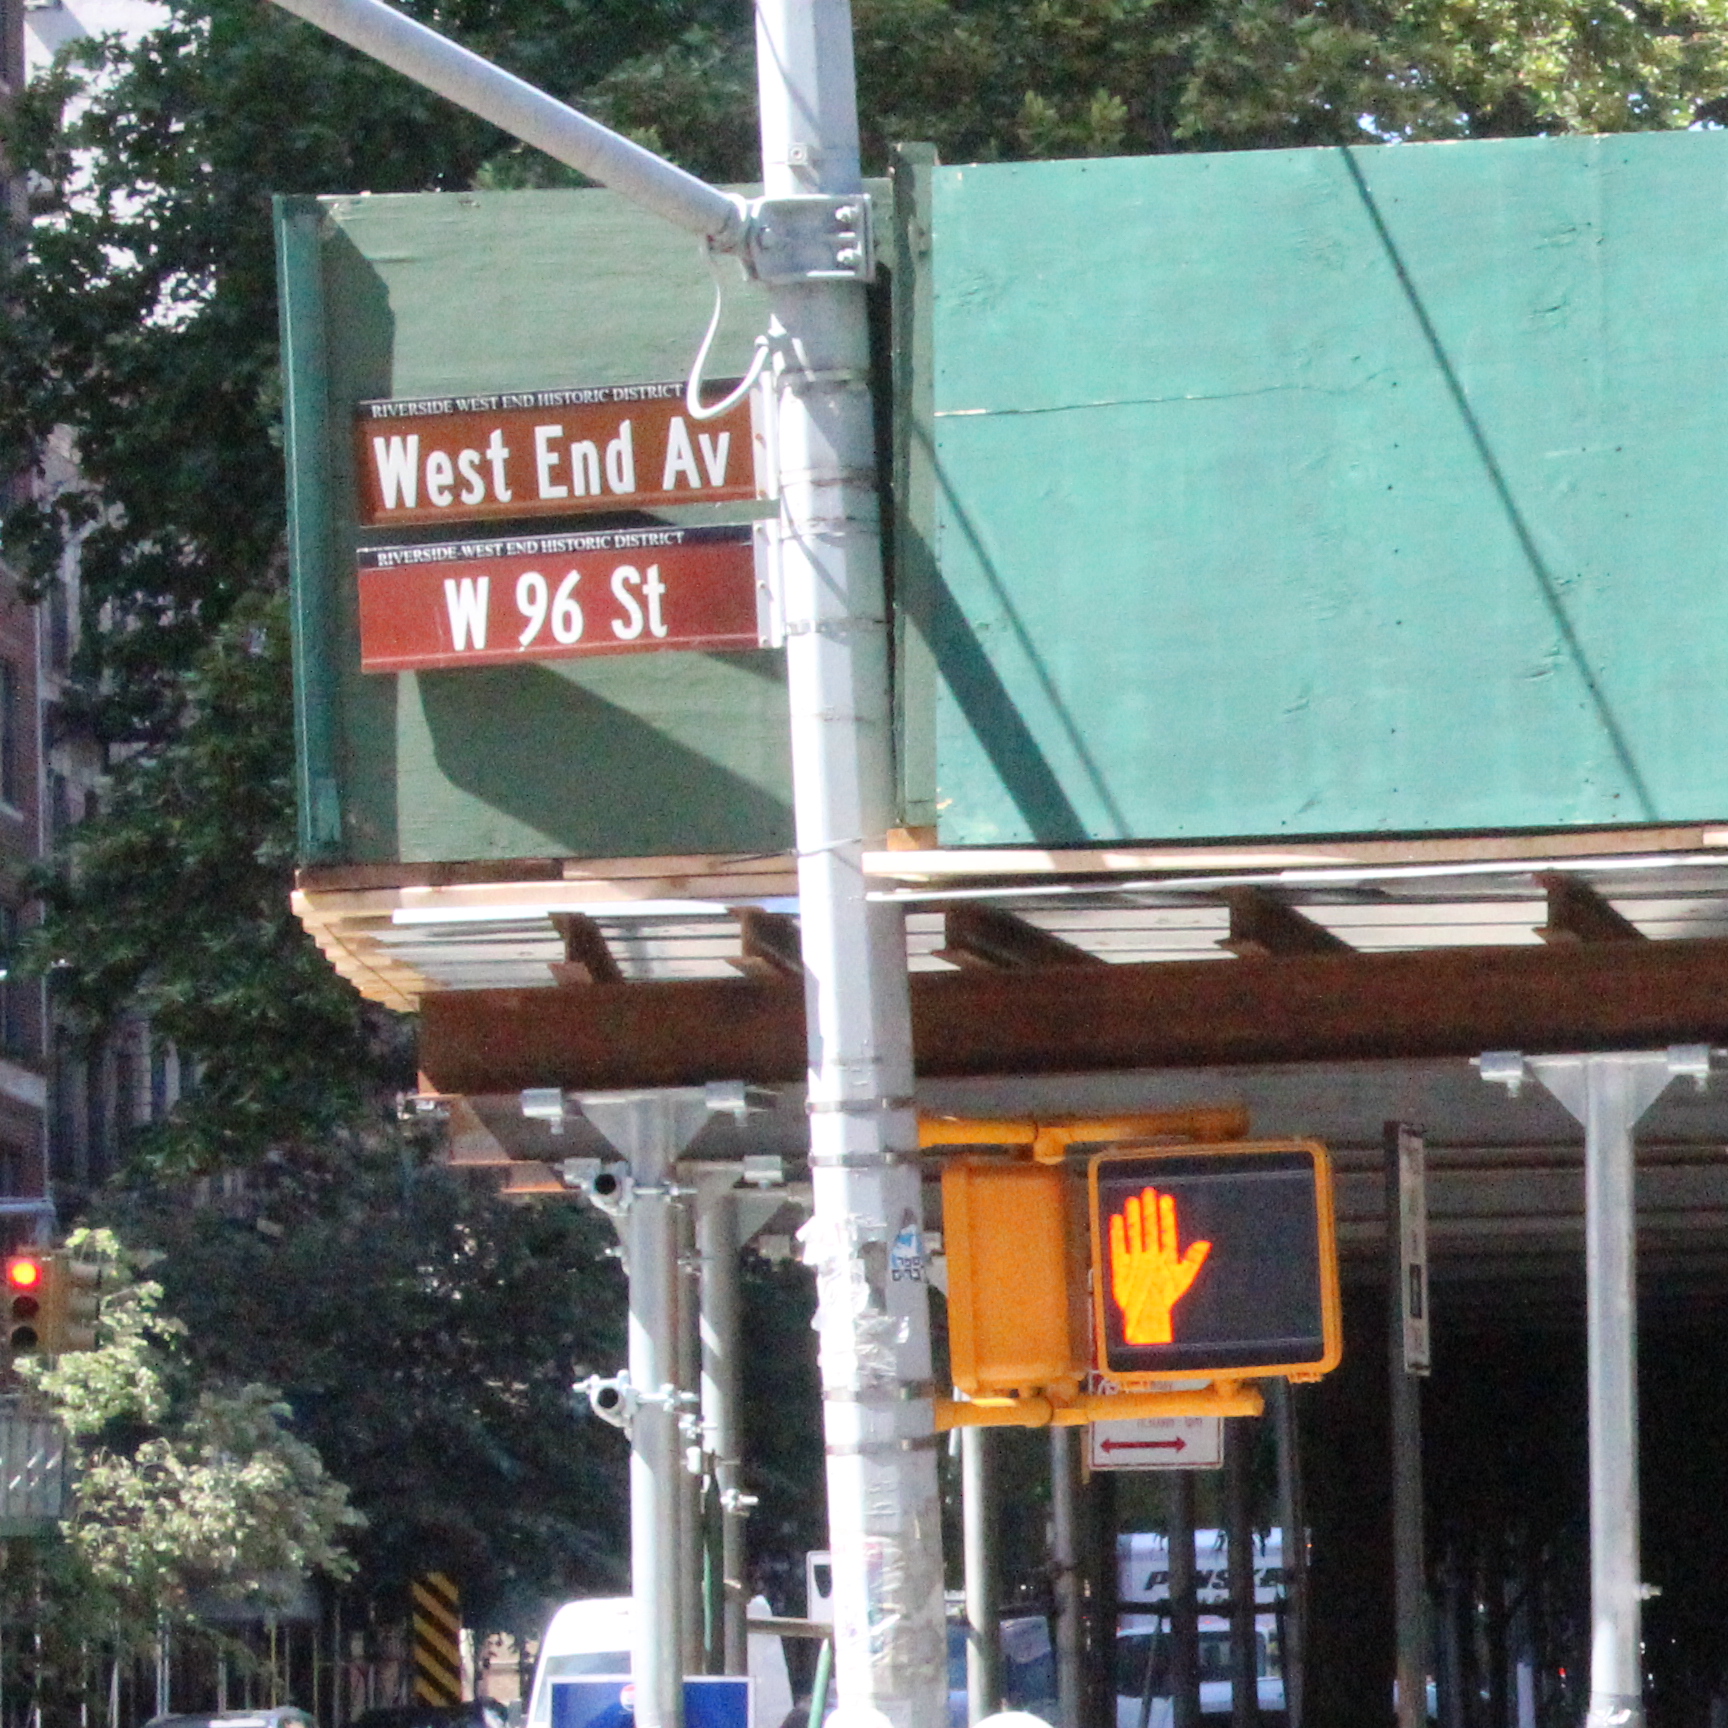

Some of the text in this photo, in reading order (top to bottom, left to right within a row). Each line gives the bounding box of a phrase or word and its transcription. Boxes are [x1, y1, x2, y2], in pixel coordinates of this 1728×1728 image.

[372, 384, 684, 418] RIVERSIDE WEST END HISTORIC DISTRICT
[373, 416, 731, 511] West End Av
[506, 540, 539, 556] END
[541, 536, 611, 554] HISTORIC
[614, 530, 685, 549] DISTRICT
[444, 564, 668, 652] W 96 St
